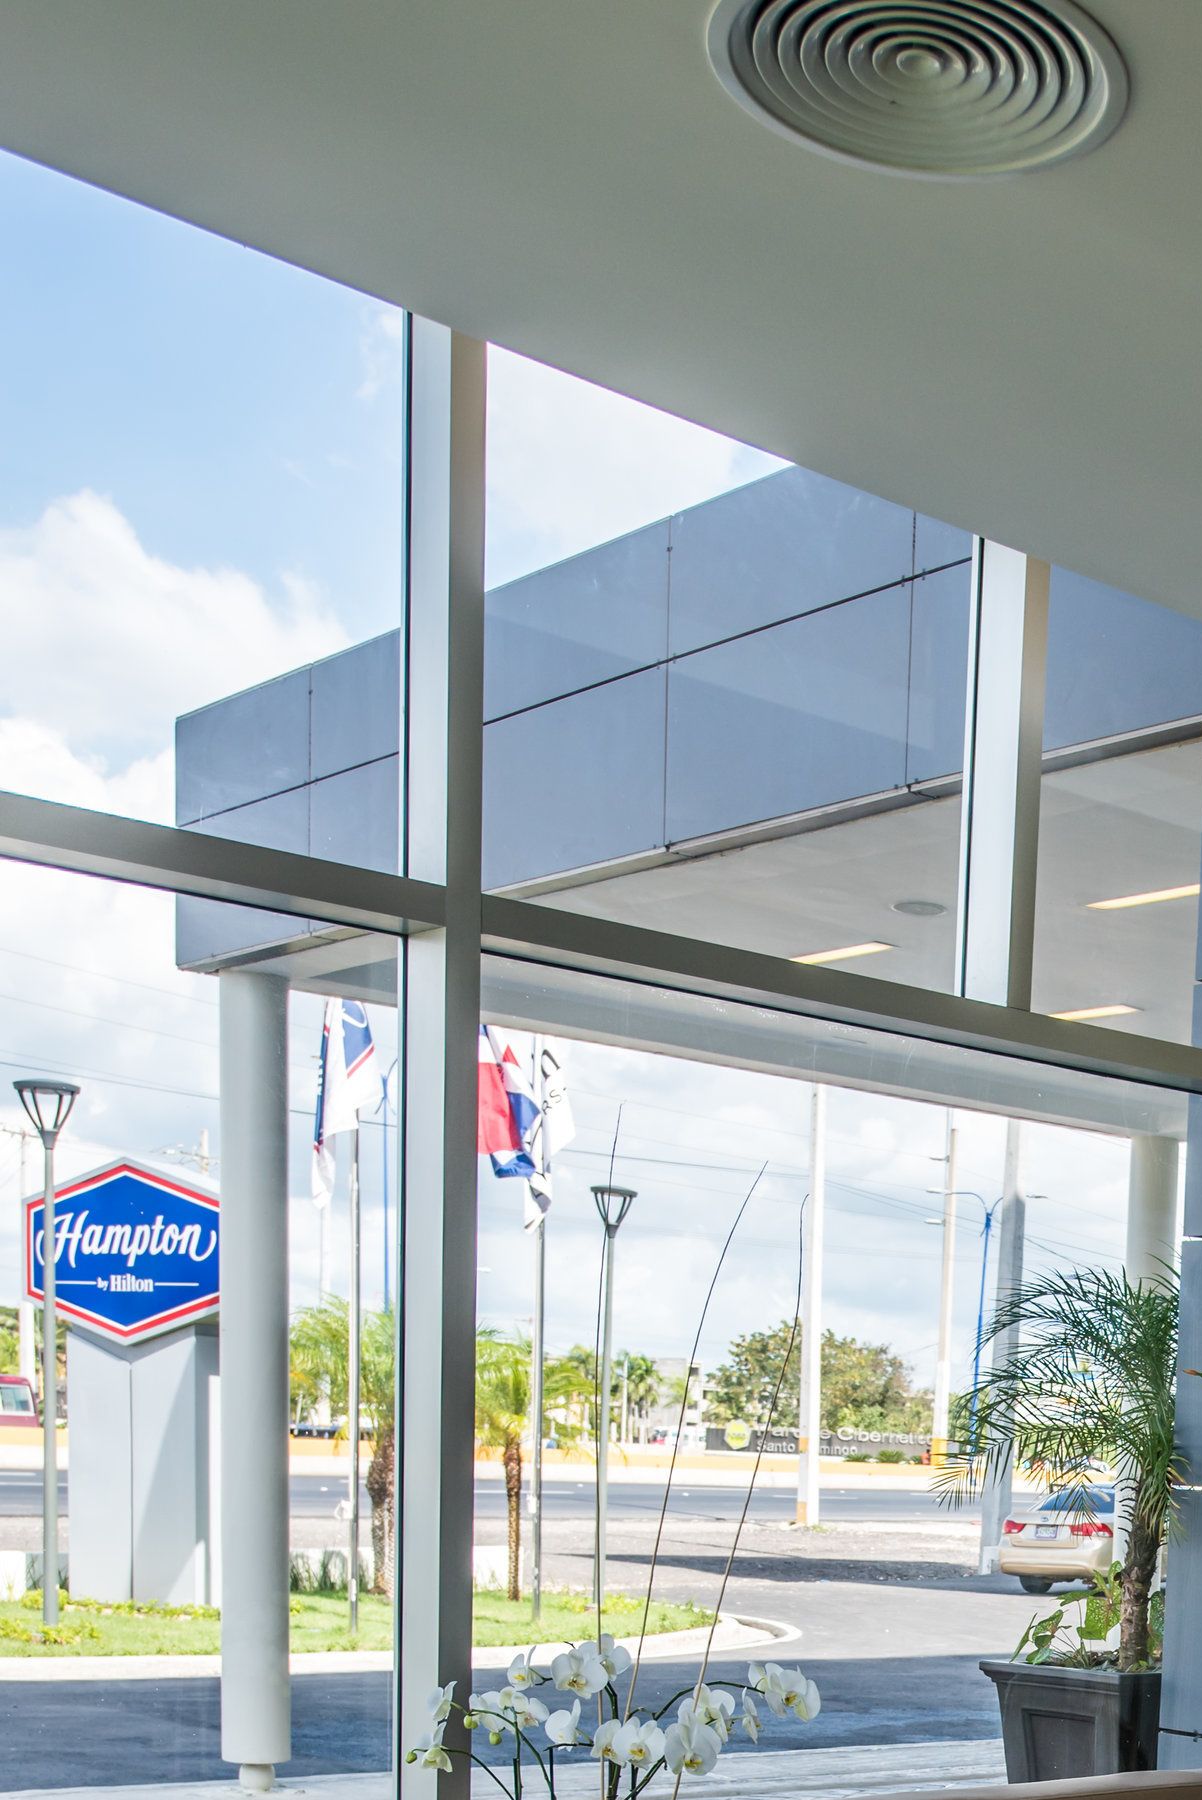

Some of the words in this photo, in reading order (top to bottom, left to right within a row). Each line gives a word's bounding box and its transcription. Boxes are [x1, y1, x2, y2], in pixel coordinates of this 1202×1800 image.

[36, 1210, 217, 1268] Hampton
[97, 1276, 109, 1291] by
[110, 1273, 154, 1292] Hilton
[756, 1422, 832, 1439] Pare
[757, 1440, 796, 1453] Santo
